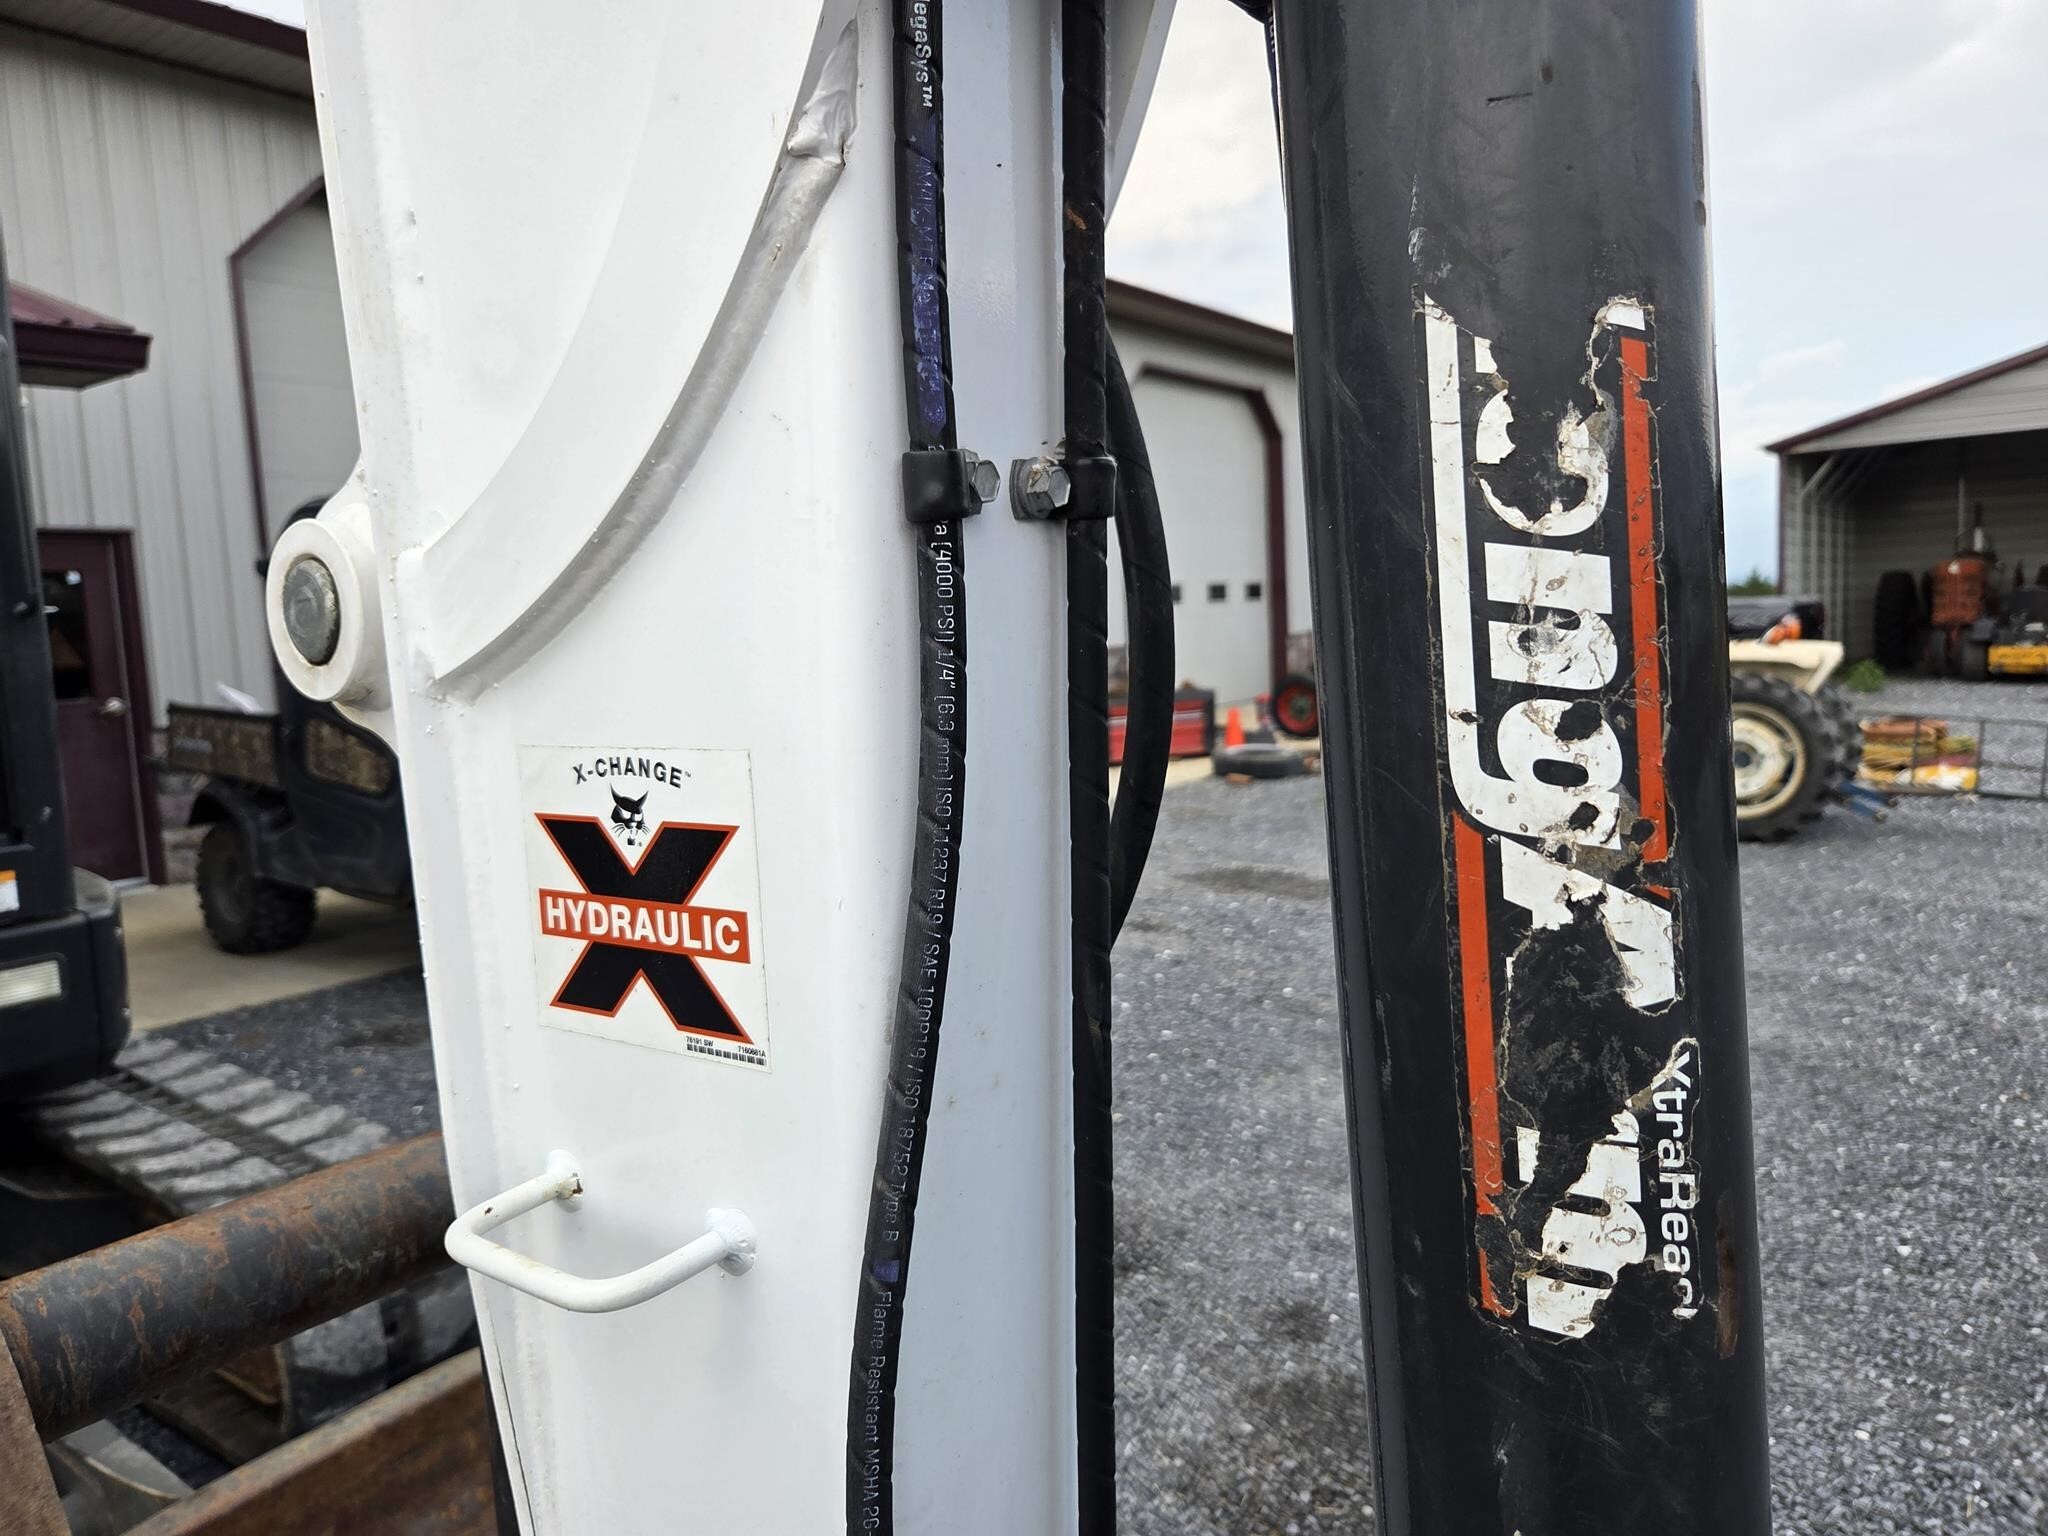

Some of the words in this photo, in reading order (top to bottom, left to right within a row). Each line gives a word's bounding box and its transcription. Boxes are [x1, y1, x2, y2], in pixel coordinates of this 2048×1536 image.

[908, 0, 933, 108] egaSys™
[933, 786, 952, 817] ISO
[929, 823, 949, 883] 11237
[546, 895, 741, 955] HYDRAULIC
[925, 888, 945, 924] R19
[918, 943, 939, 980] SAE
[902, 1077, 922, 1109] ISO
[889, 1115, 916, 1176] 18752
[881, 1181, 905, 1224] Type
[880, 1230, 899, 1242] B
[868, 1290, 892, 1350] Flame
[863, 1355, 886, 1443] Resistant
[861, 1448, 880, 1502] MSHA
